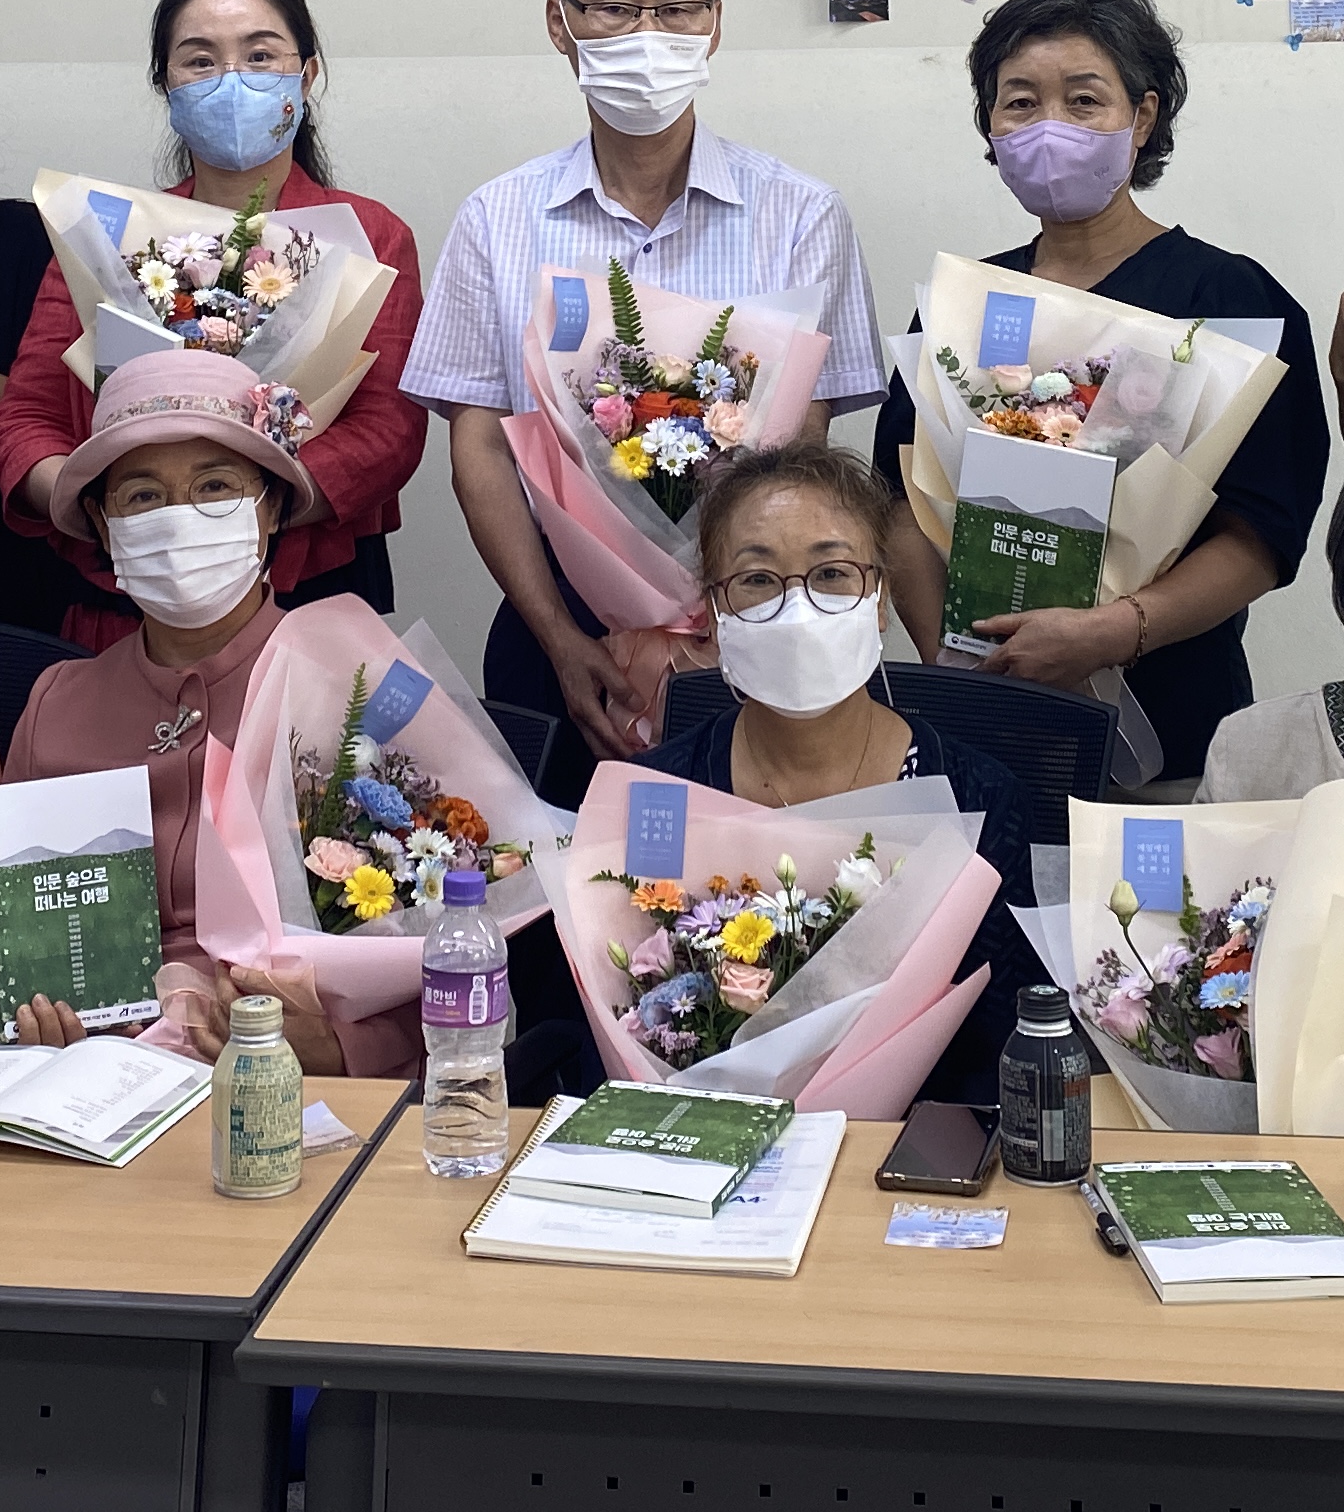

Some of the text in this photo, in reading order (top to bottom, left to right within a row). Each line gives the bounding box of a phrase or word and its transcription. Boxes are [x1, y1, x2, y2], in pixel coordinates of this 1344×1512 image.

[993, 521, 1059, 549] 인문 숲으로
[990, 538, 1057, 566] 떠나는 여행
[33, 867, 109, 893] 인문 숲으로
[34, 885, 110, 912] 떠나는 여행
